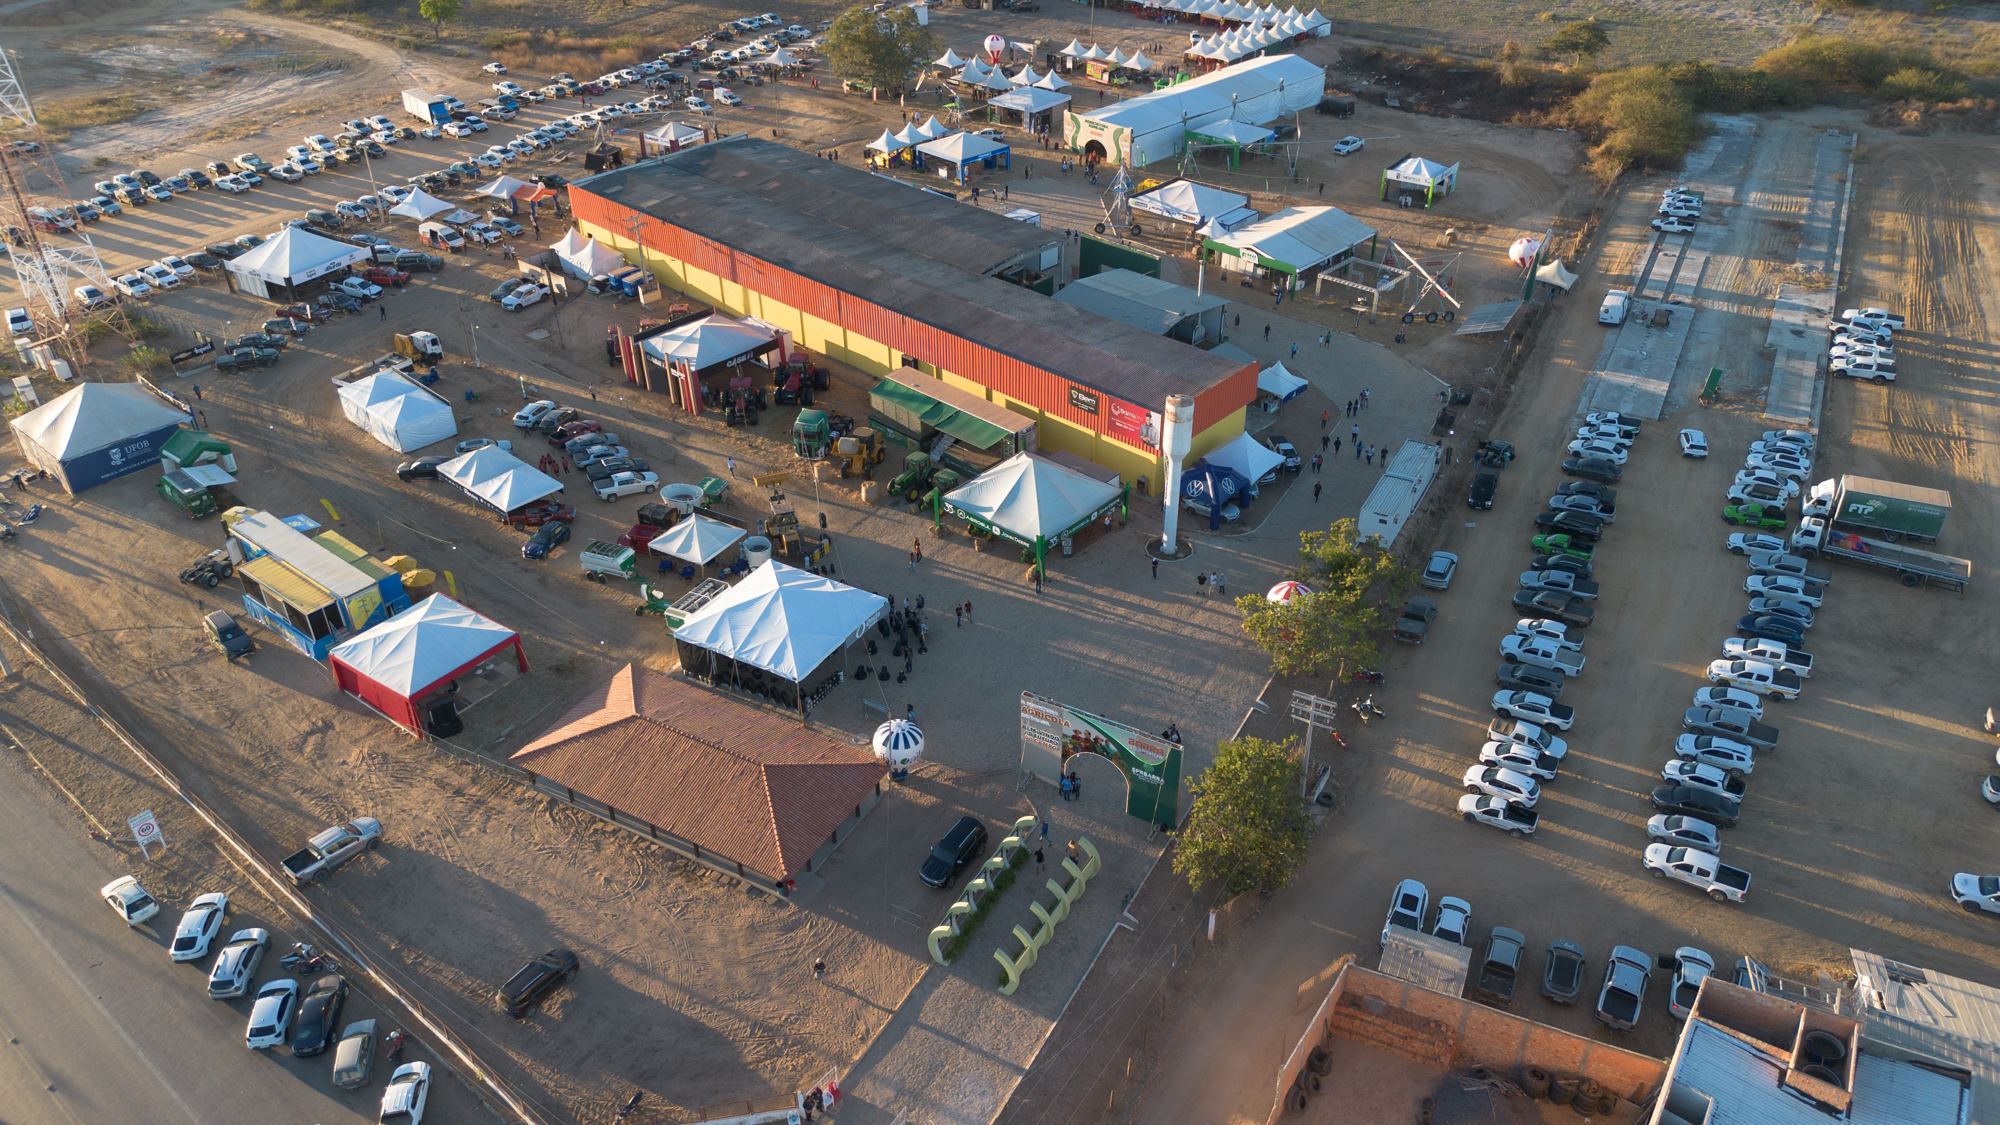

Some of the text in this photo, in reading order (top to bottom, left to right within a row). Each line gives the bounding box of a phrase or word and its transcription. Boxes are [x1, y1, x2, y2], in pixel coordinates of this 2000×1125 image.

[124, 439, 150, 454] UFOB
[1848, 503, 1874, 515] FTP
[141, 824, 151, 833] 60
